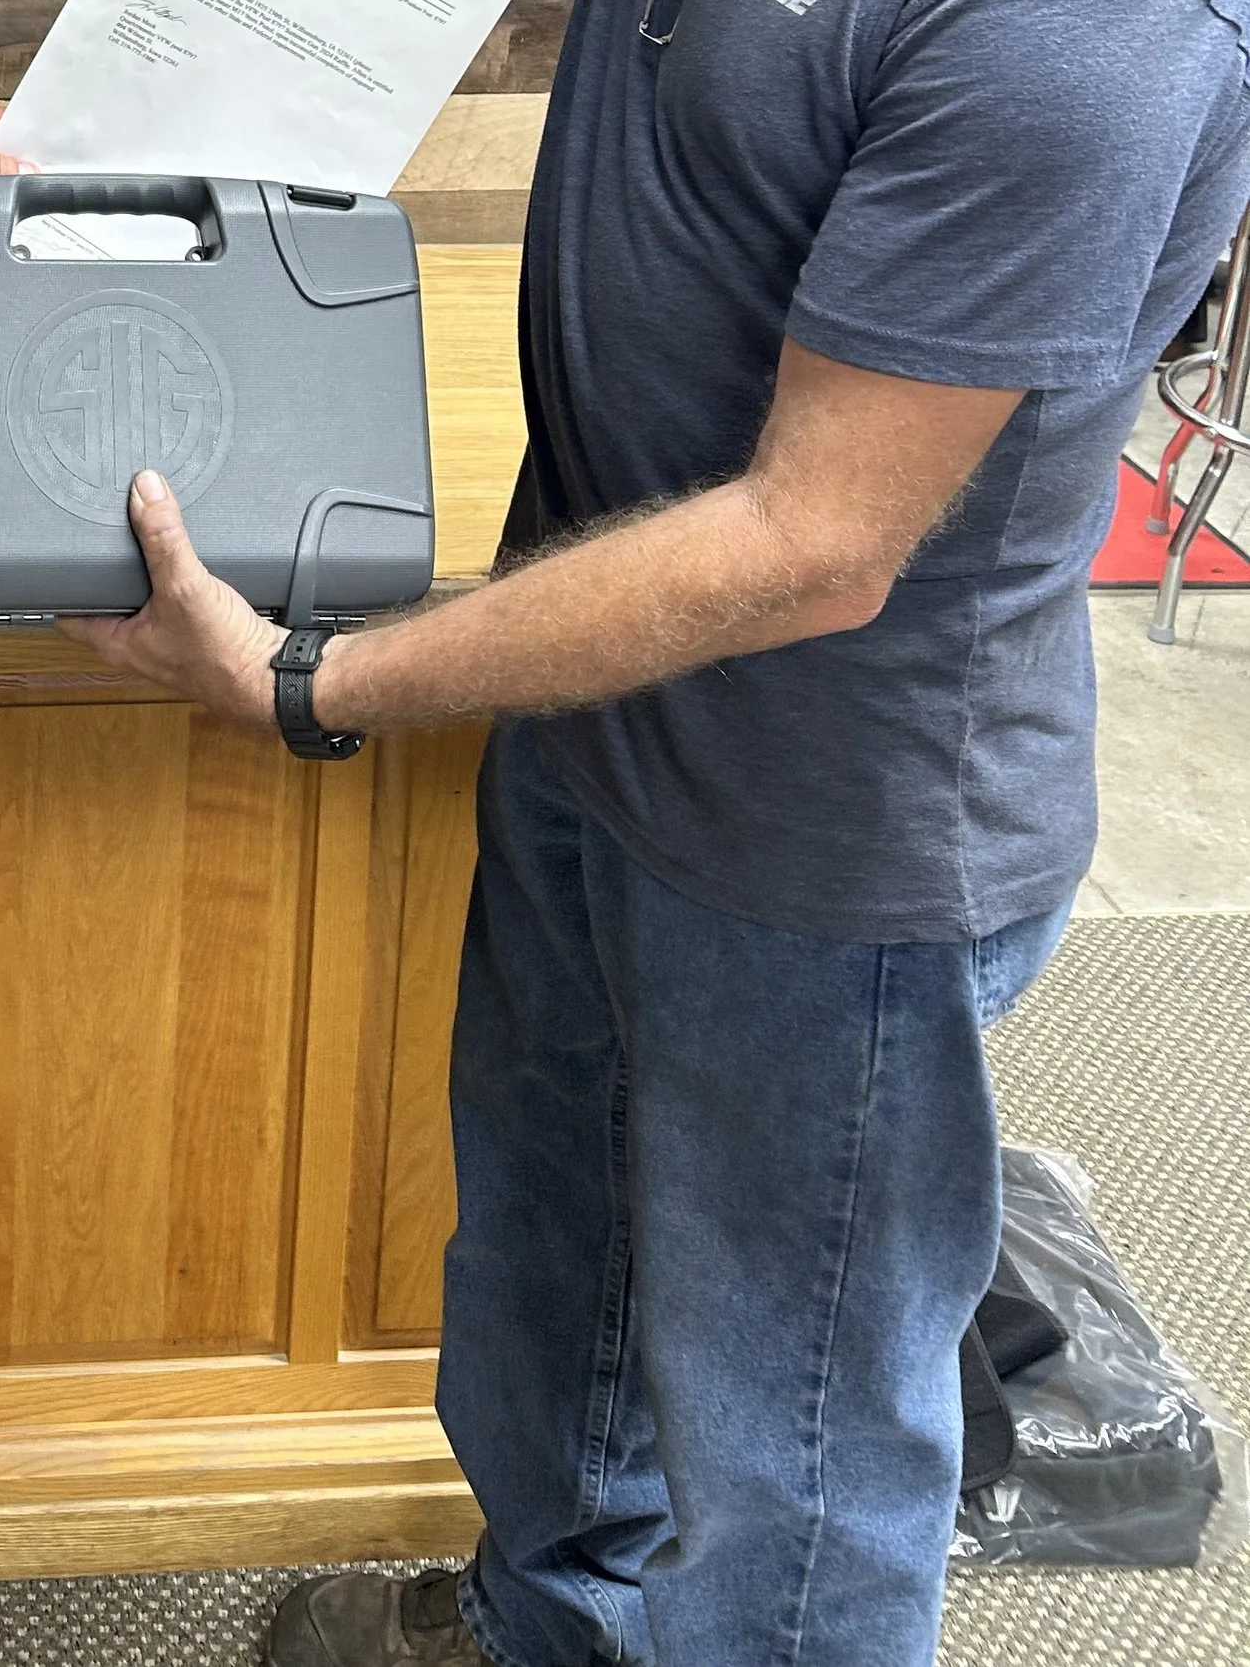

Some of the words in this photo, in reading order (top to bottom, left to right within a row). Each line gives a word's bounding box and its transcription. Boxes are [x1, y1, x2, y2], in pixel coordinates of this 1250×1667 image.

[244, 3, 258, 15] VFW
[284, 27, 307, 43] Summer
[156, 33, 171, 45] VFW
[251, 26, 273, 41] Federal
[315, 55, 345, 75] completion
[39, 320, 208, 492] SIG
